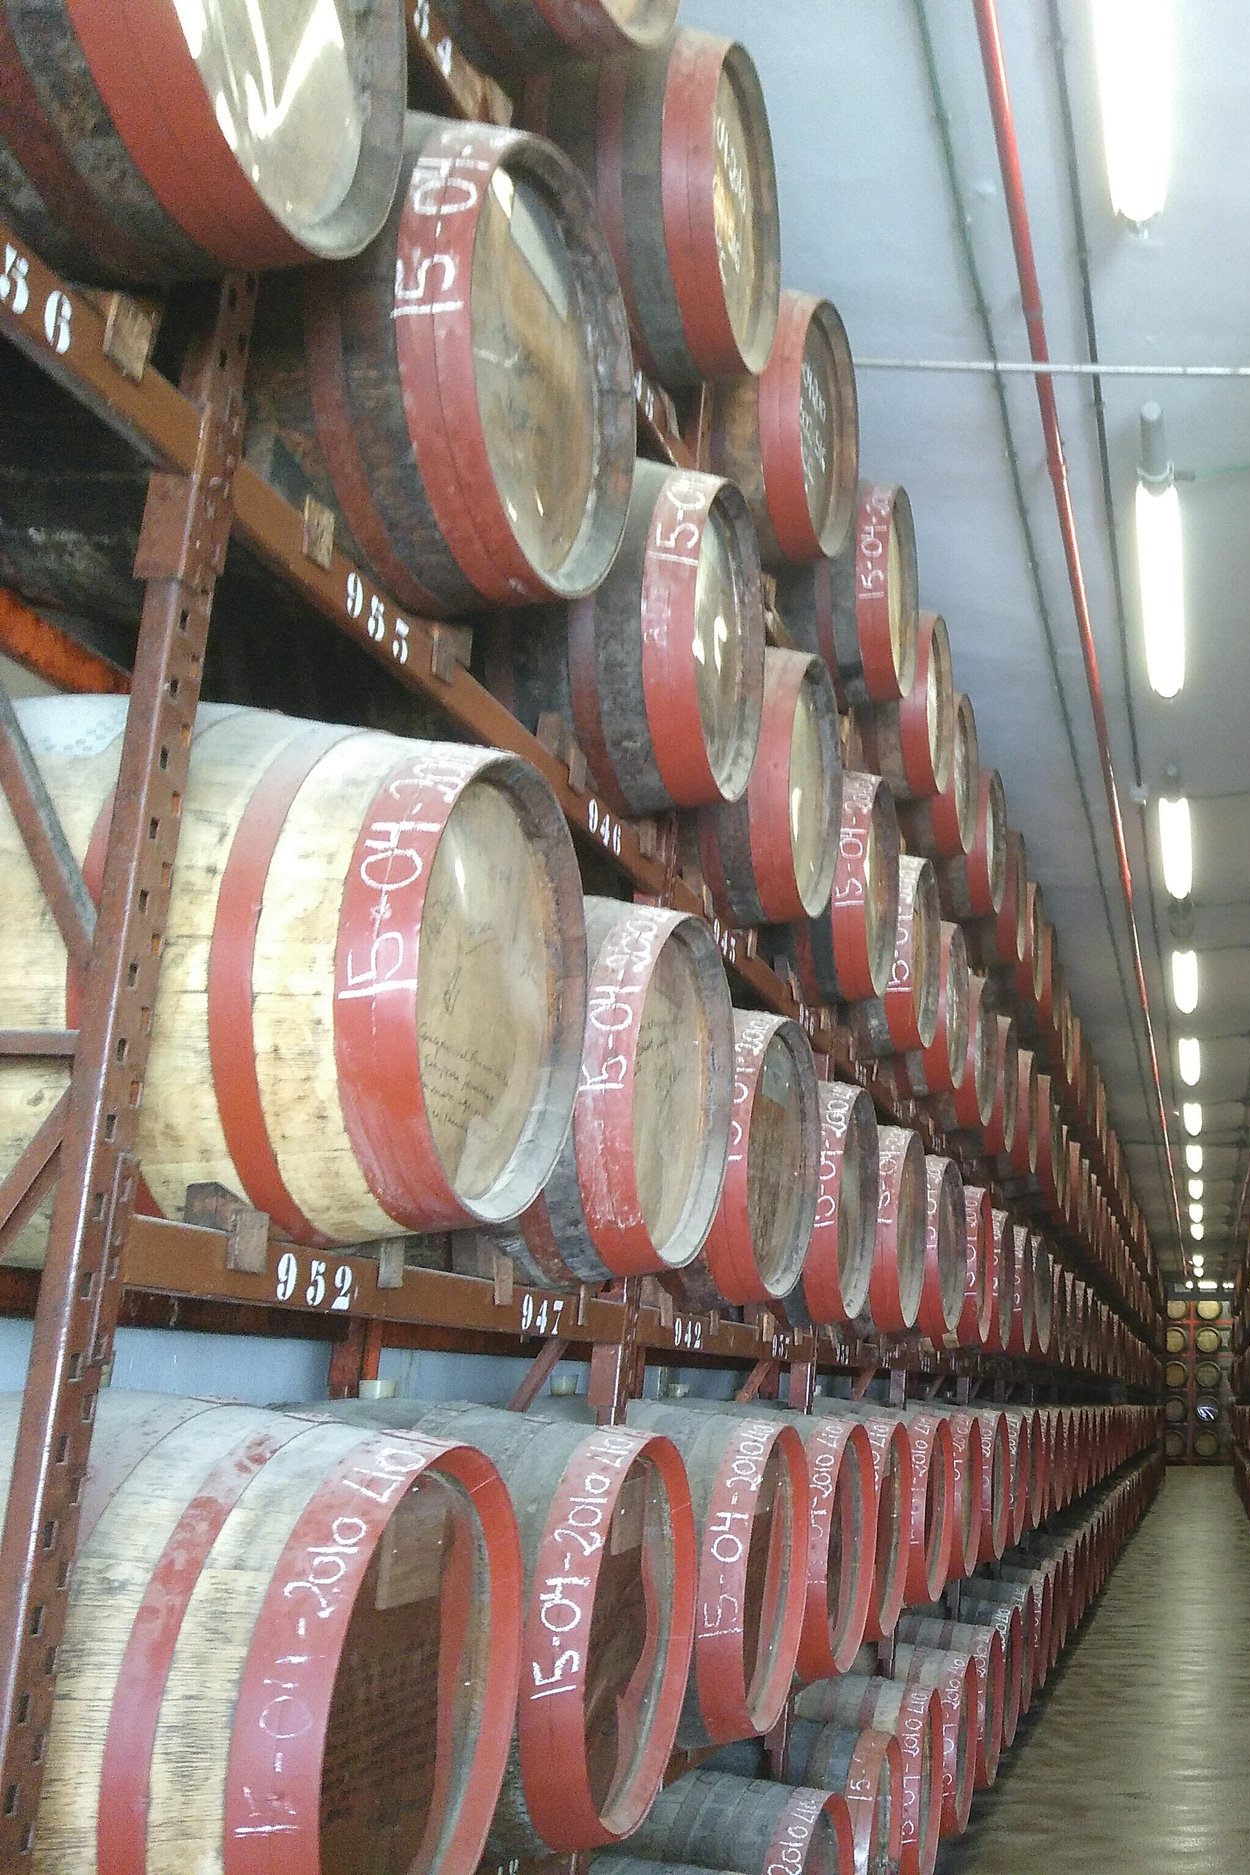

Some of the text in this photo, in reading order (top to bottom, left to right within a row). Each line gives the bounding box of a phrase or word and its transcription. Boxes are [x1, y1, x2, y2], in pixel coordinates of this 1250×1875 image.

[276, 1252, 351, 1311] 952
[521, 1293, 564, 1335] 947
[674, 1317, 702, 1349] 942
[530, 1471, 612, 1700] 15-04-2010
